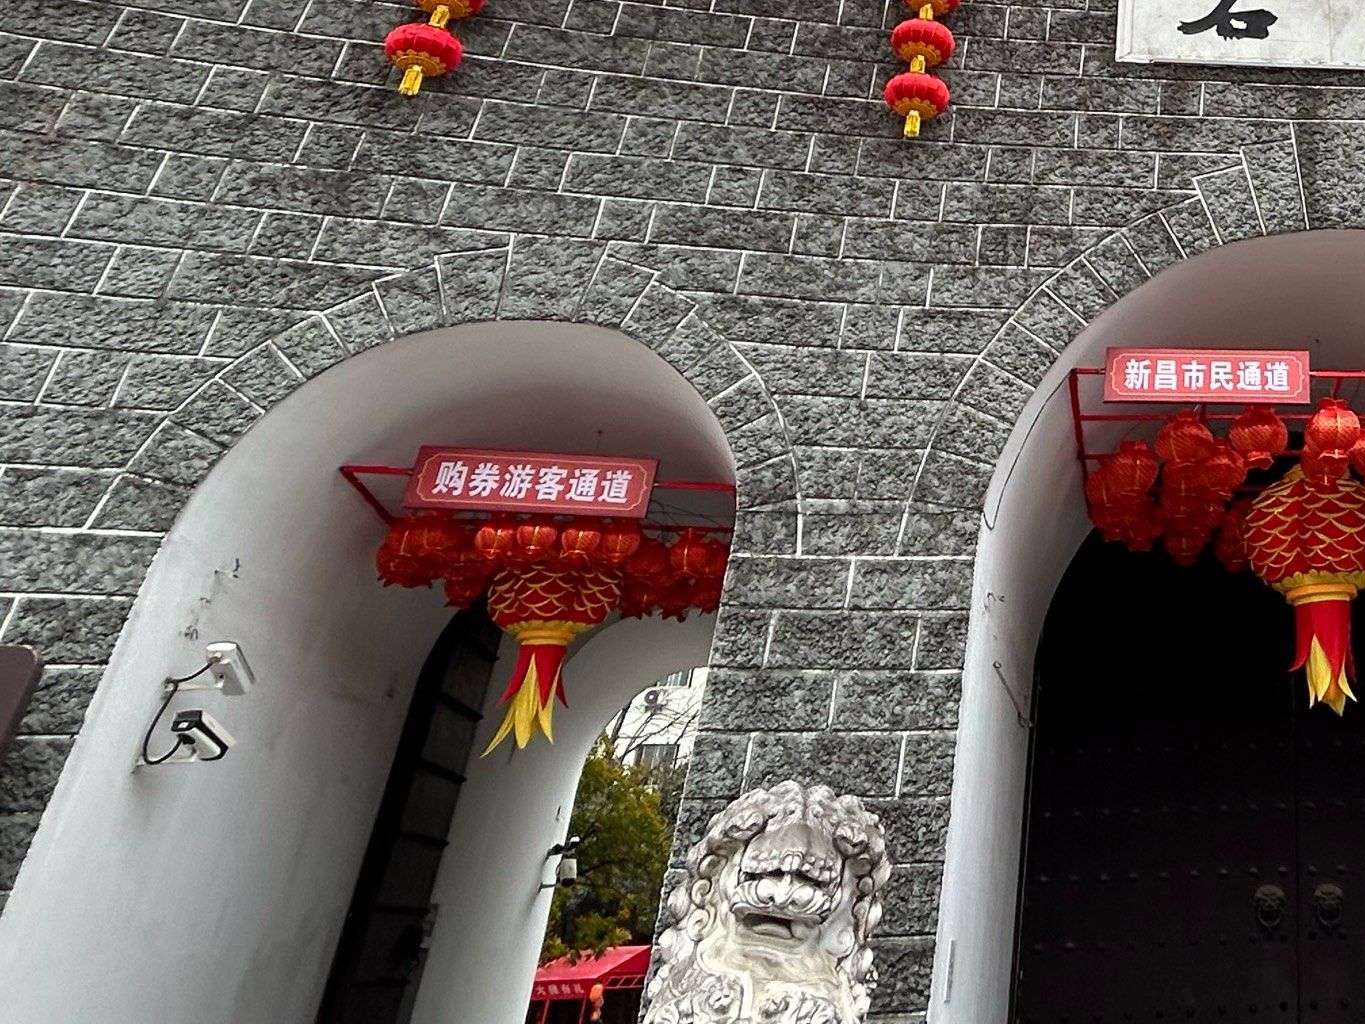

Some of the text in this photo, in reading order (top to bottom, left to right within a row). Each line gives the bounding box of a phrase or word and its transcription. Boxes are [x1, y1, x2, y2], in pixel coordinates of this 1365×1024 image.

[1124, 358, 1290, 391] 新昌市民通道
[432, 461, 632, 503] 购券游客通道
